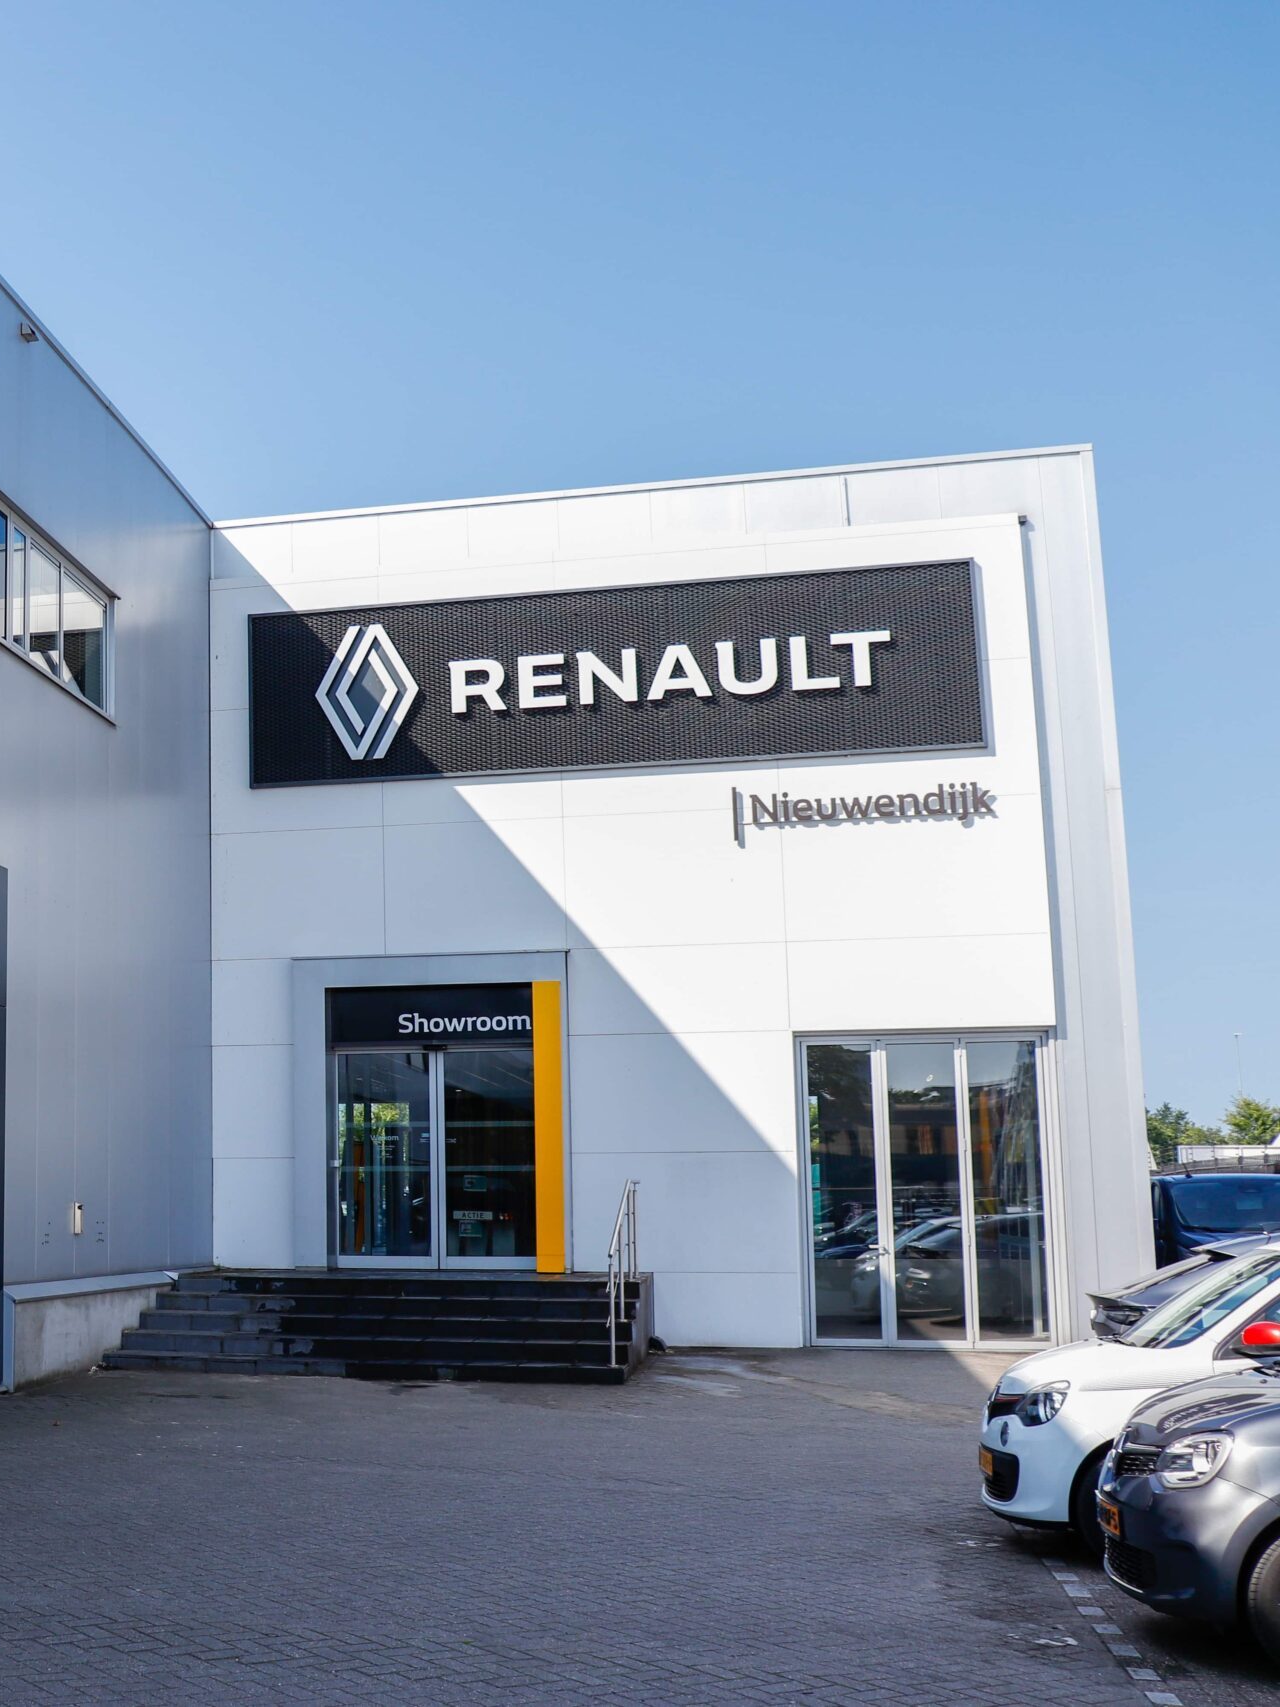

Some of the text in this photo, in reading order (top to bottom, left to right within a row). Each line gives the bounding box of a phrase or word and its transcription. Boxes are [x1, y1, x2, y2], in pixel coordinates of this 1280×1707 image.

[448, 630, 891, 714] RENAULT
[750, 782, 993, 822] Nieuwendijk
[398, 1013, 531, 1033] Showroom
[462, 1211, 485, 1219] ACTIE
